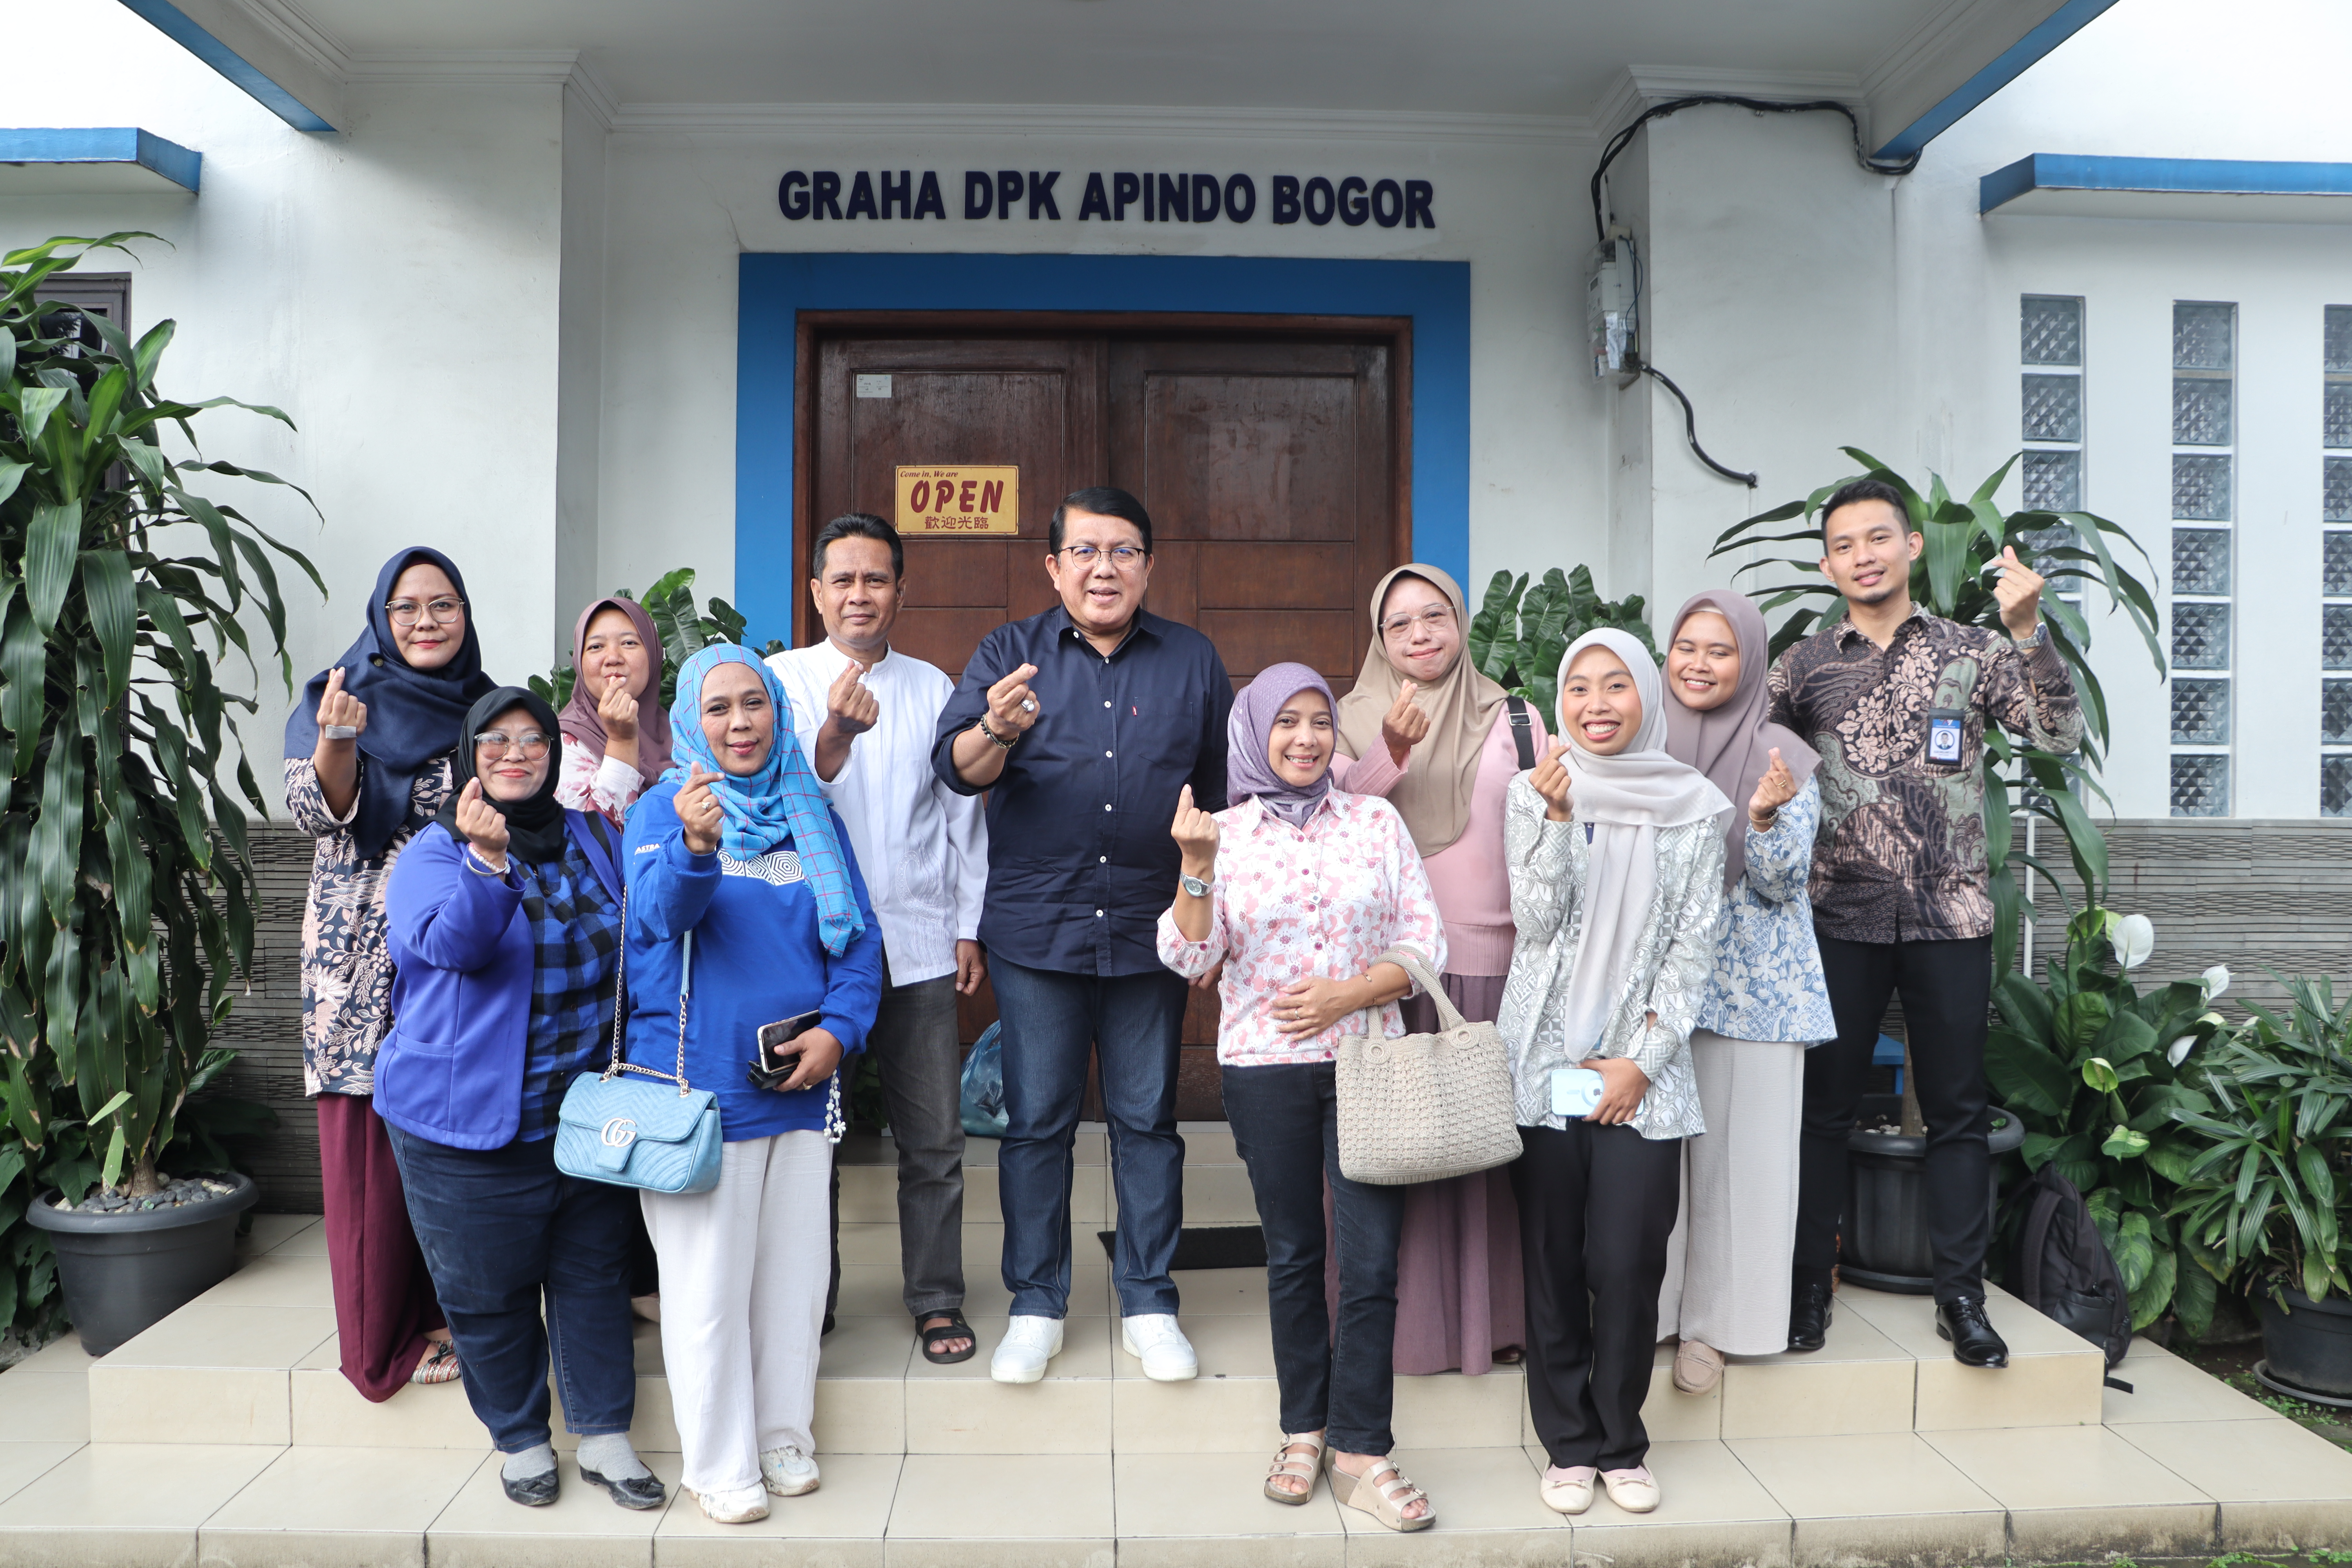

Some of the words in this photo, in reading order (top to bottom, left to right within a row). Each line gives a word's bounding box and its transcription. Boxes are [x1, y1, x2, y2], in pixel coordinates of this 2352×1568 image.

[778, 170, 947, 221] GRAHA
[964, 170, 1062, 221] DPK
[1078, 172, 1256, 224] APINDO
[1272, 175, 1436, 229] BOGOR
[911, 479, 1004, 513] OPEN
[924, 515, 989, 530] 歡迎光臨
[635, 843, 660, 853] ASTRA
